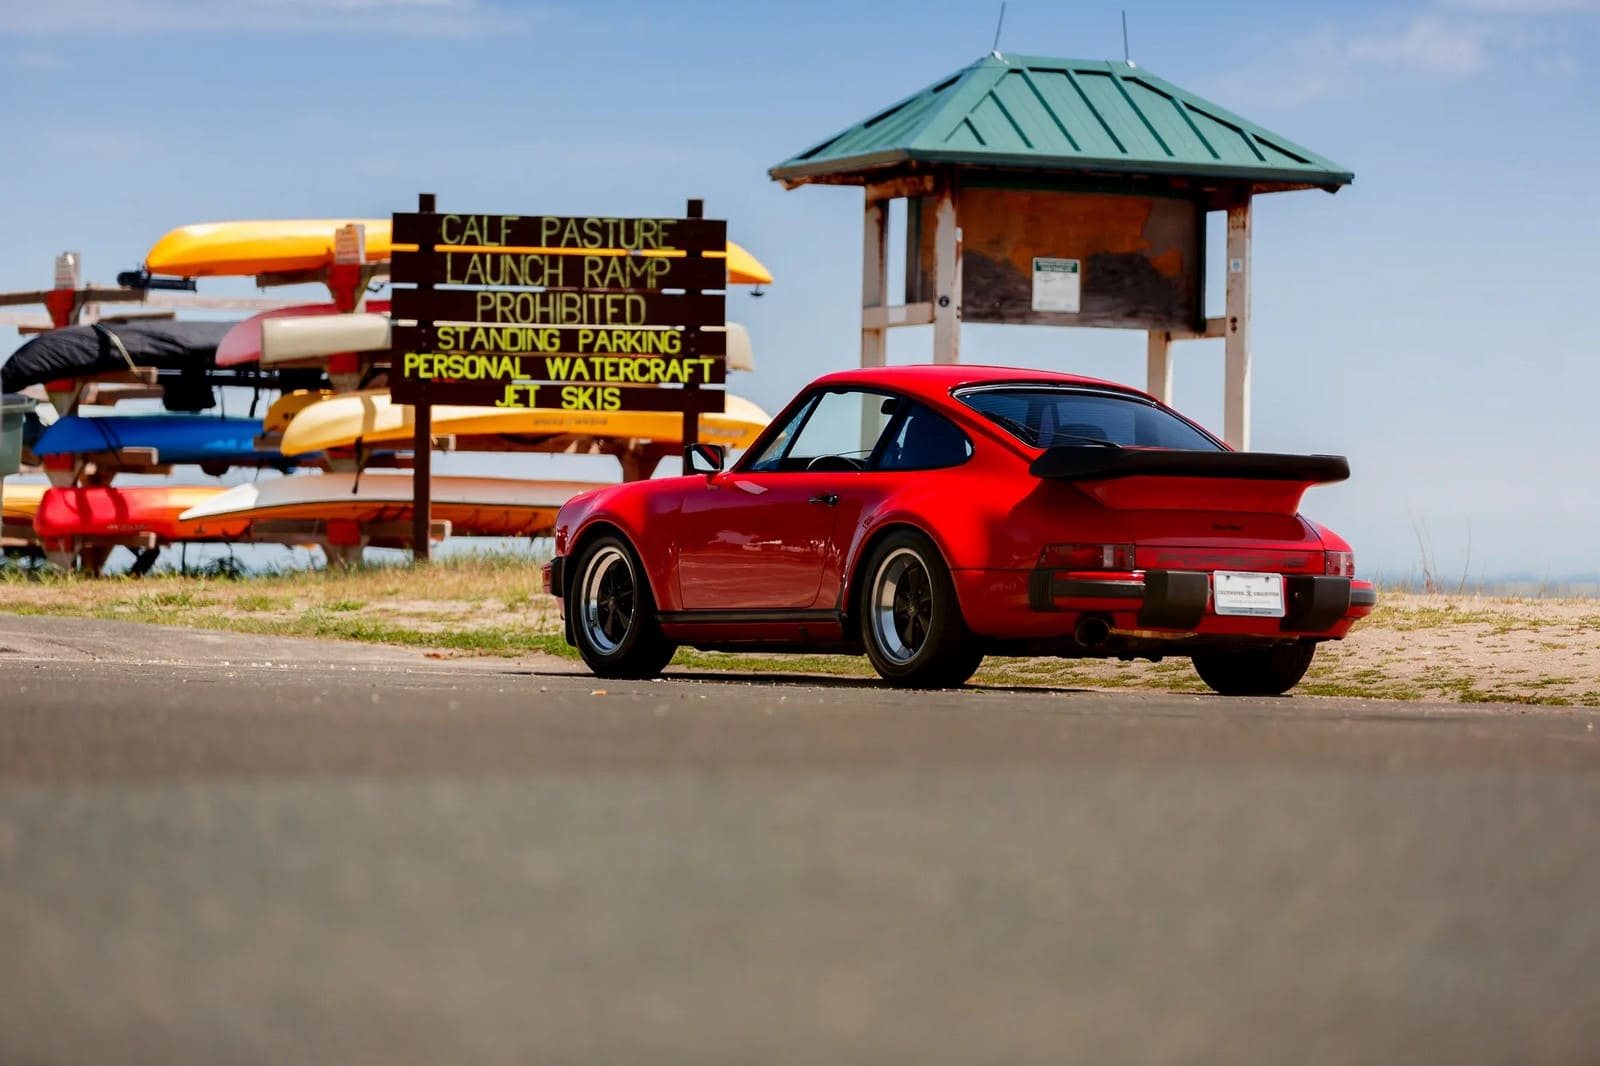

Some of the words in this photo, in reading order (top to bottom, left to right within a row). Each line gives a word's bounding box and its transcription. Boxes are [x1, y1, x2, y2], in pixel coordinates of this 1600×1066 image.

[441, 214, 520, 246] CALF
[541, 216, 678, 250] PASTURE
[446, 252, 564, 288] LAUNCH
[584, 255, 671, 289] RAMP
[475, 292, 646, 326] PROHIBITED
[437, 327, 561, 352] STANDING
[578, 329, 681, 354] PARKING
[404, 353, 532, 379] PERSONAL
[545, 357, 716, 383] WATERCRAFT
[495, 384, 541, 408] JET
[561, 386, 622, 410] SKIS
